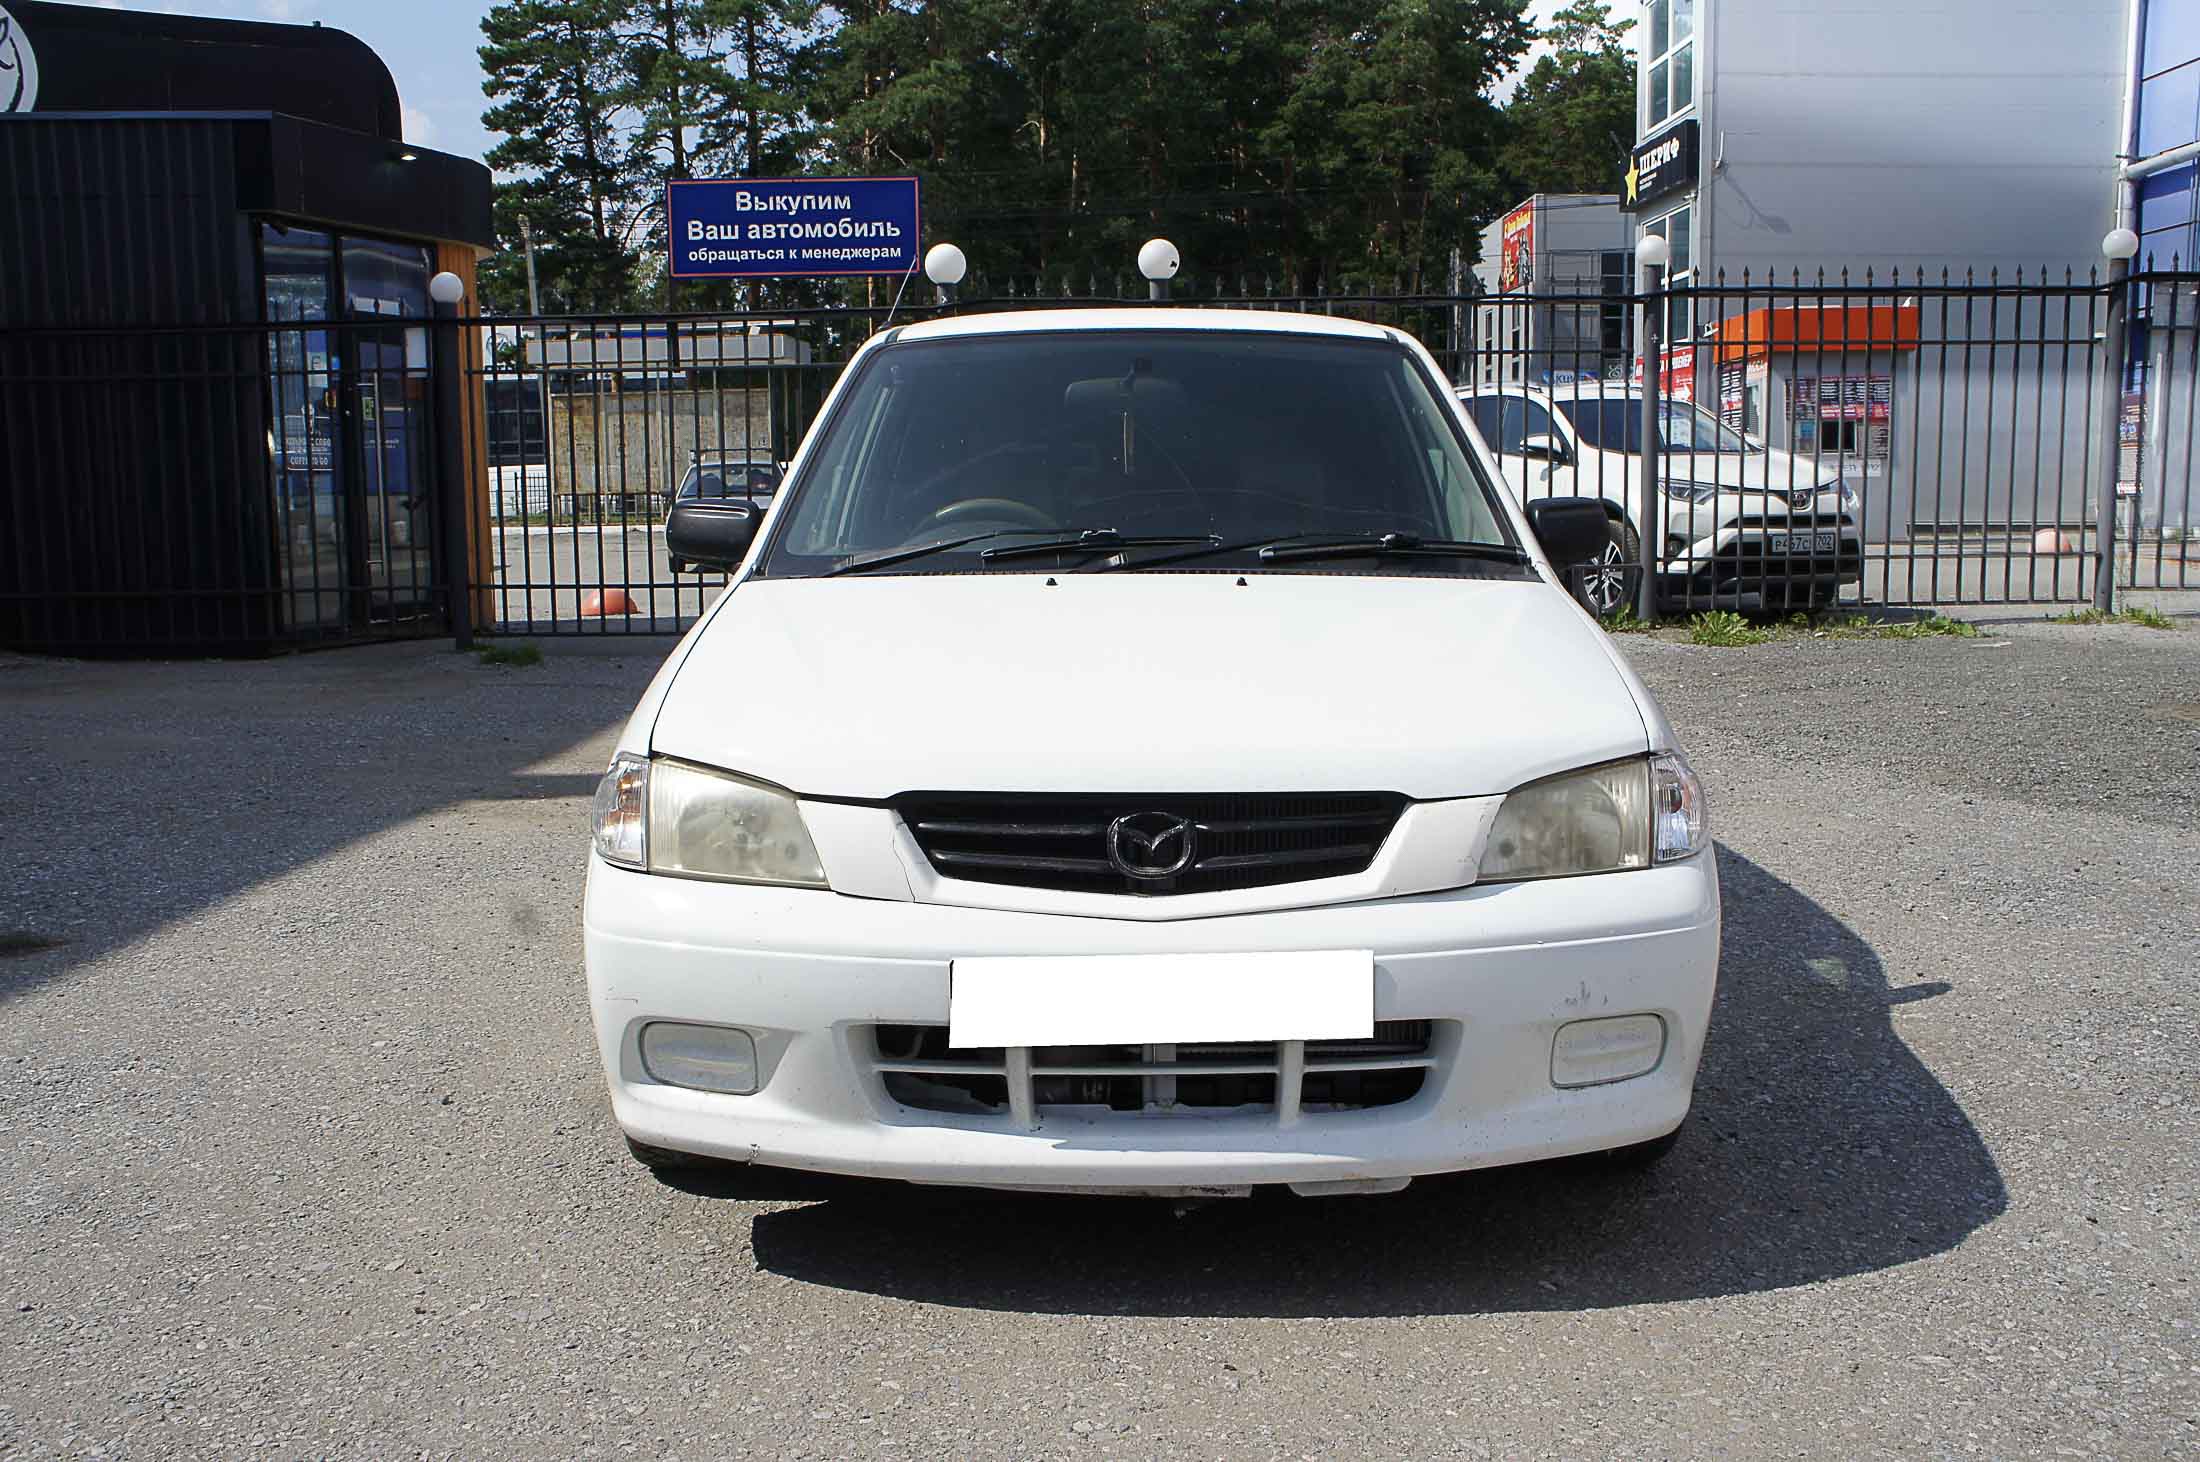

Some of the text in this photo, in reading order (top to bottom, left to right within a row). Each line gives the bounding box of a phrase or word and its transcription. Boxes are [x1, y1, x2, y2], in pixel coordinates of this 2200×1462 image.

[1639, 137, 1680, 176] ШЕРИФ
[735, 190, 851, 215] Выкупим
[687, 218, 901, 241] Ваш автомобиль
[688, 245, 901, 264] обращаться к менеджерам
[290, 456, 310, 465] COFF
[1775, 535, 1832, 551] Р47С 702
